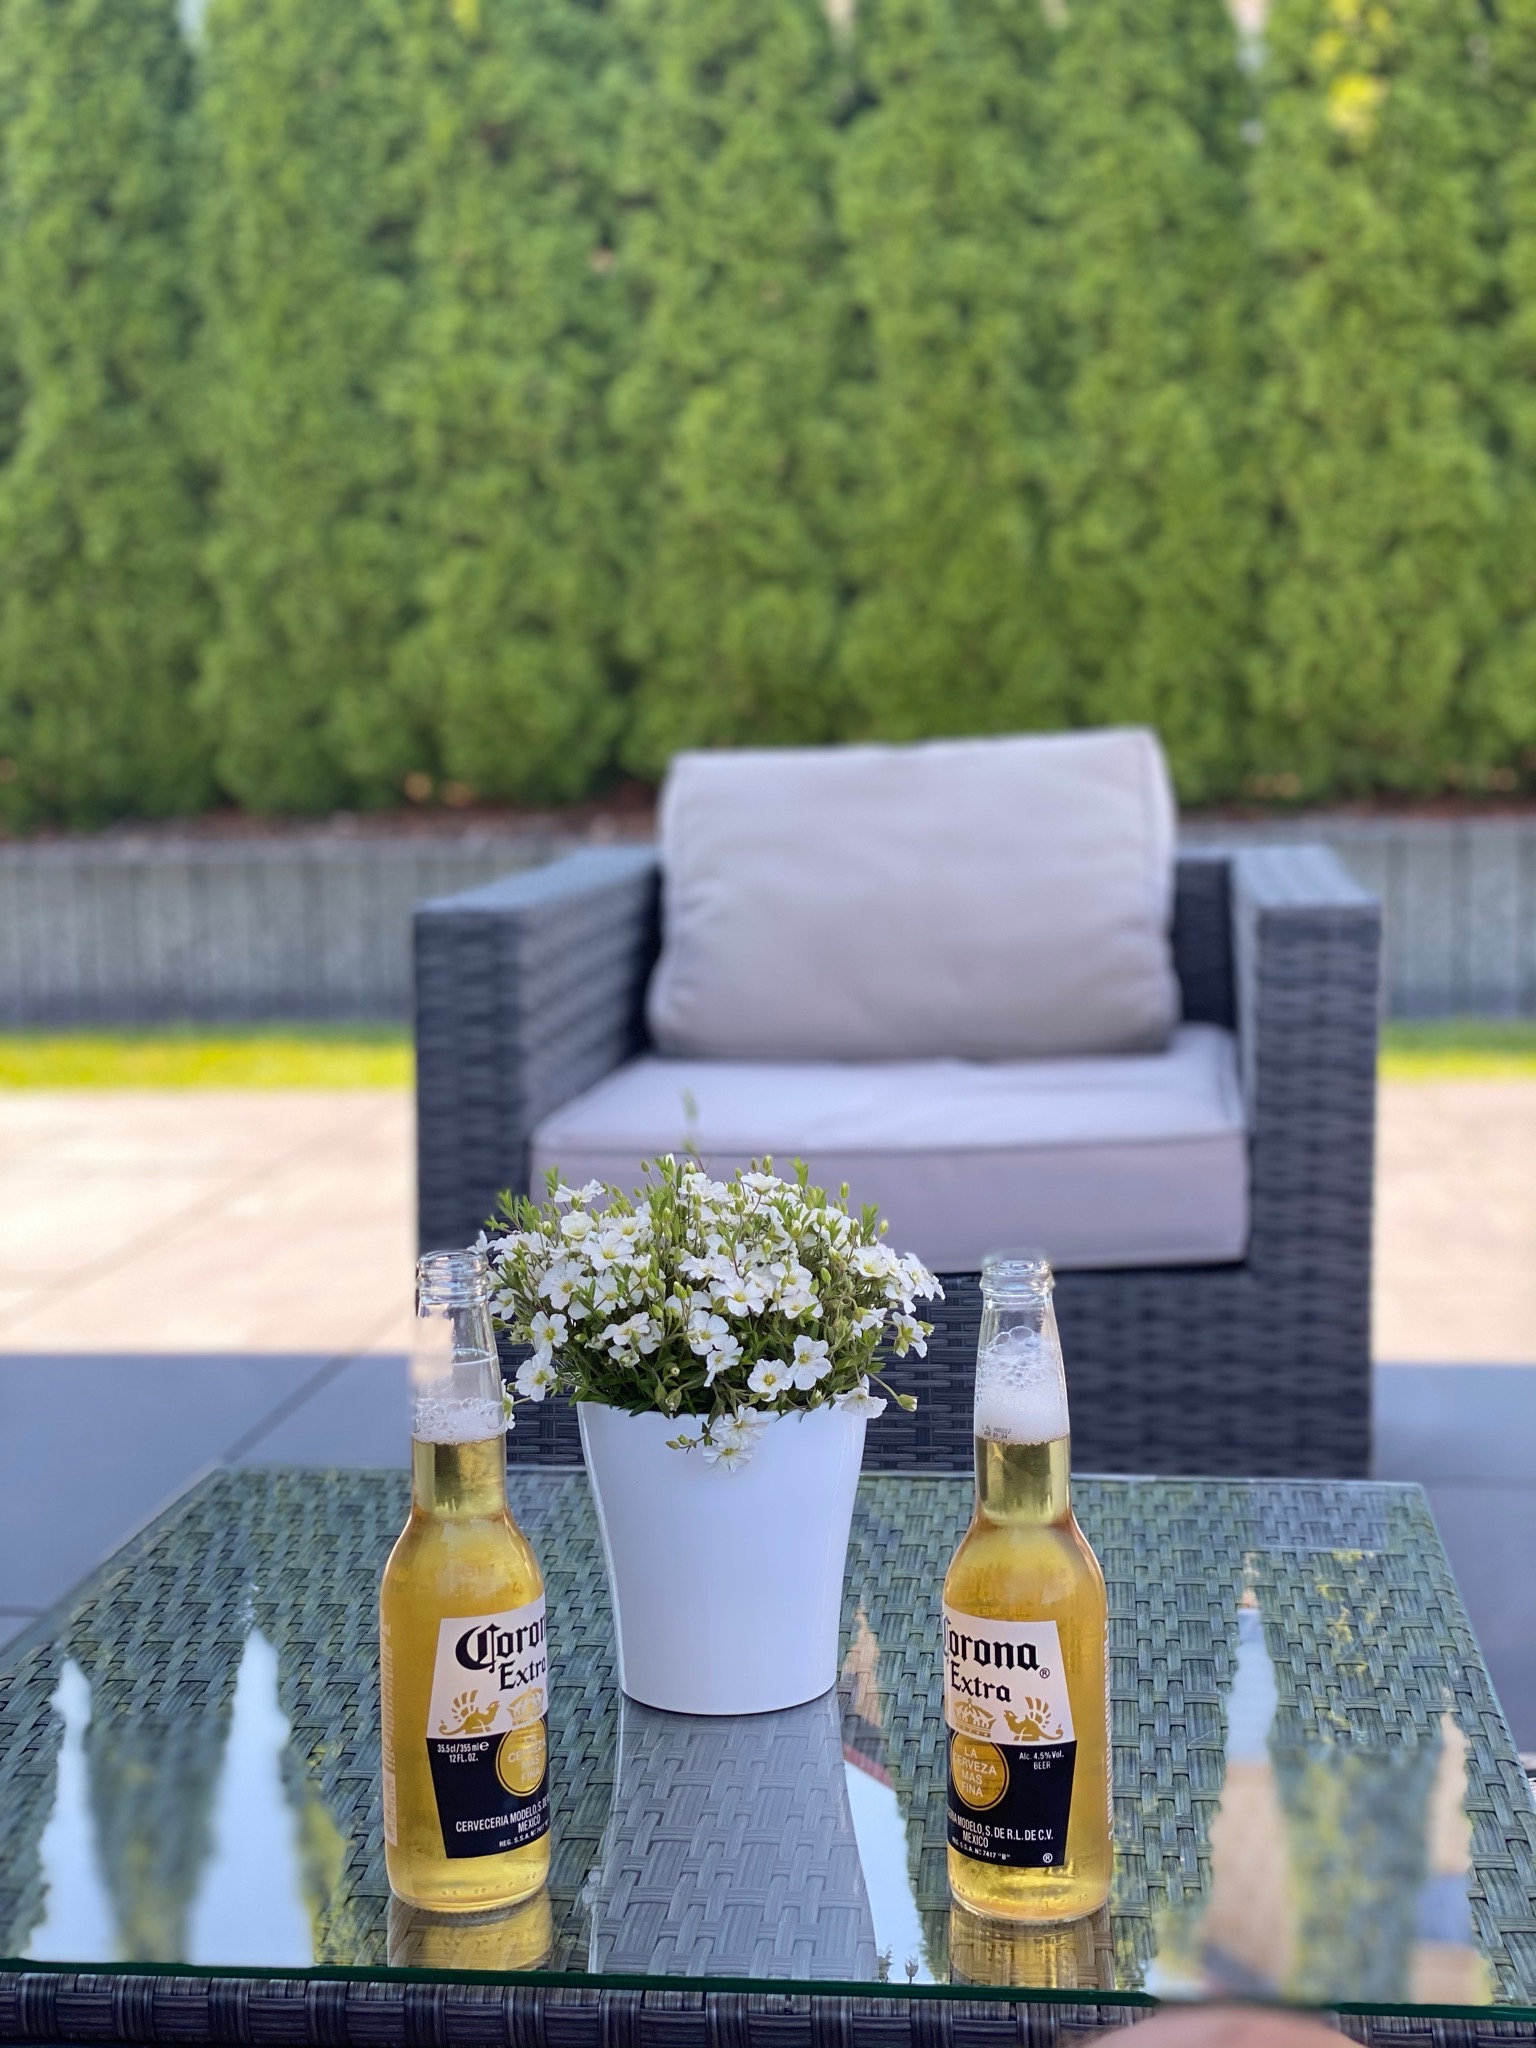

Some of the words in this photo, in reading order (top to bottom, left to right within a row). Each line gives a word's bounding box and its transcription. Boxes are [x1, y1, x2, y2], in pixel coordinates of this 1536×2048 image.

[950, 1660, 1012, 1702] Extra
[964, 1746, 978, 1759] LA
[1033, 1751, 1052, 1760] 4.5%
[1052, 1749, 1065, 1759] Vol.
[952, 1752, 998, 1776] CERVEZA
[1033, 1760, 1051, 1770] BEER
[962, 1768, 983, 1785] MAS
[962, 1780, 984, 1798] FINA
[455, 1814, 509, 1833] CERVECERIA
[517, 1813, 541, 1834] MEXICO
[962, 1830, 989, 1849] MEXICO
[985, 1825, 994, 1838] S.
[994, 1826, 1006, 1839] DE
[1007, 1828, 1024, 1841] R.L.
[1025, 1829, 1037, 1842] DE
[1038, 1828, 1054, 1841] C.V.
[983, 1850, 997, 1859] 7417
